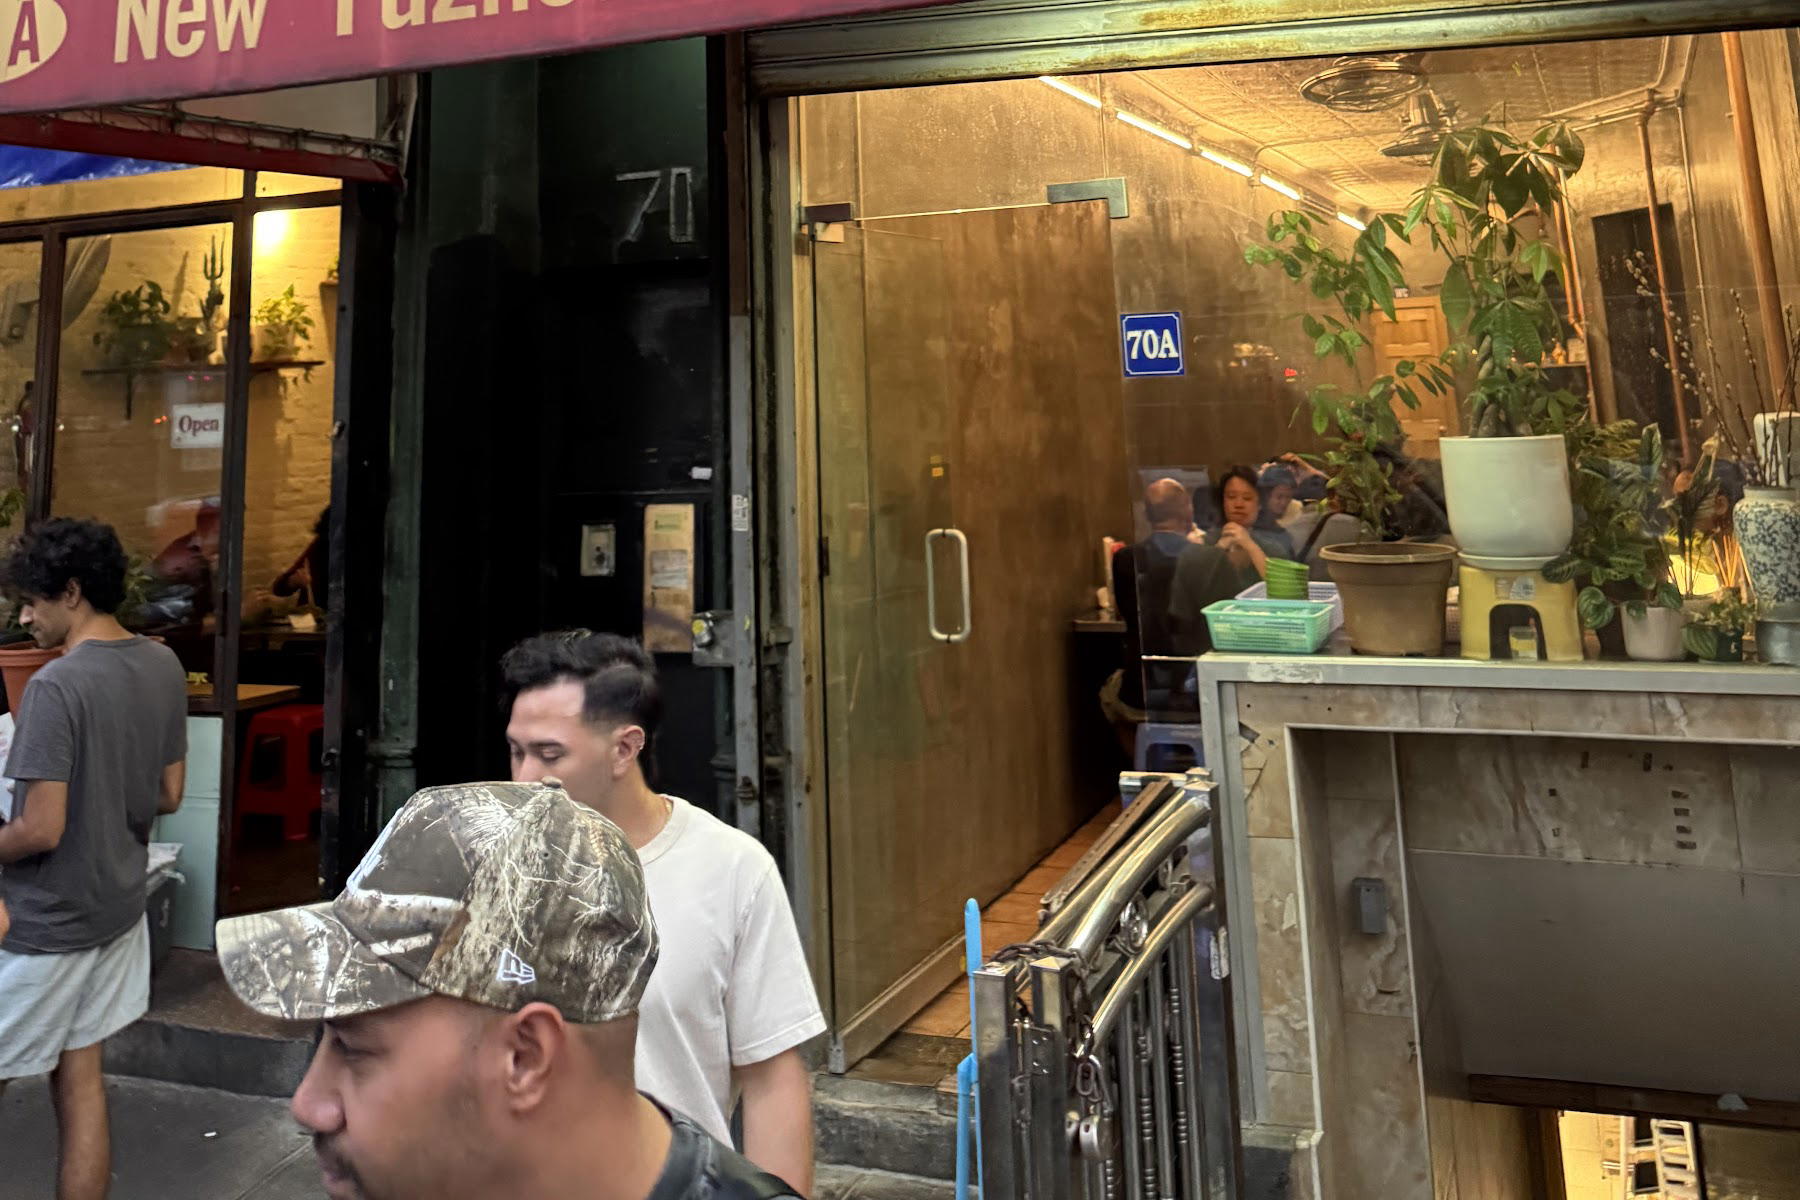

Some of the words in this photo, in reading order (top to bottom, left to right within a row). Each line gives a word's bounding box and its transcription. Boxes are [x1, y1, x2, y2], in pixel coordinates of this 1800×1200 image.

[616, 167, 693, 242] 70
[1126, 328, 1179, 360] 70A
[179, 415, 219, 437] Open
